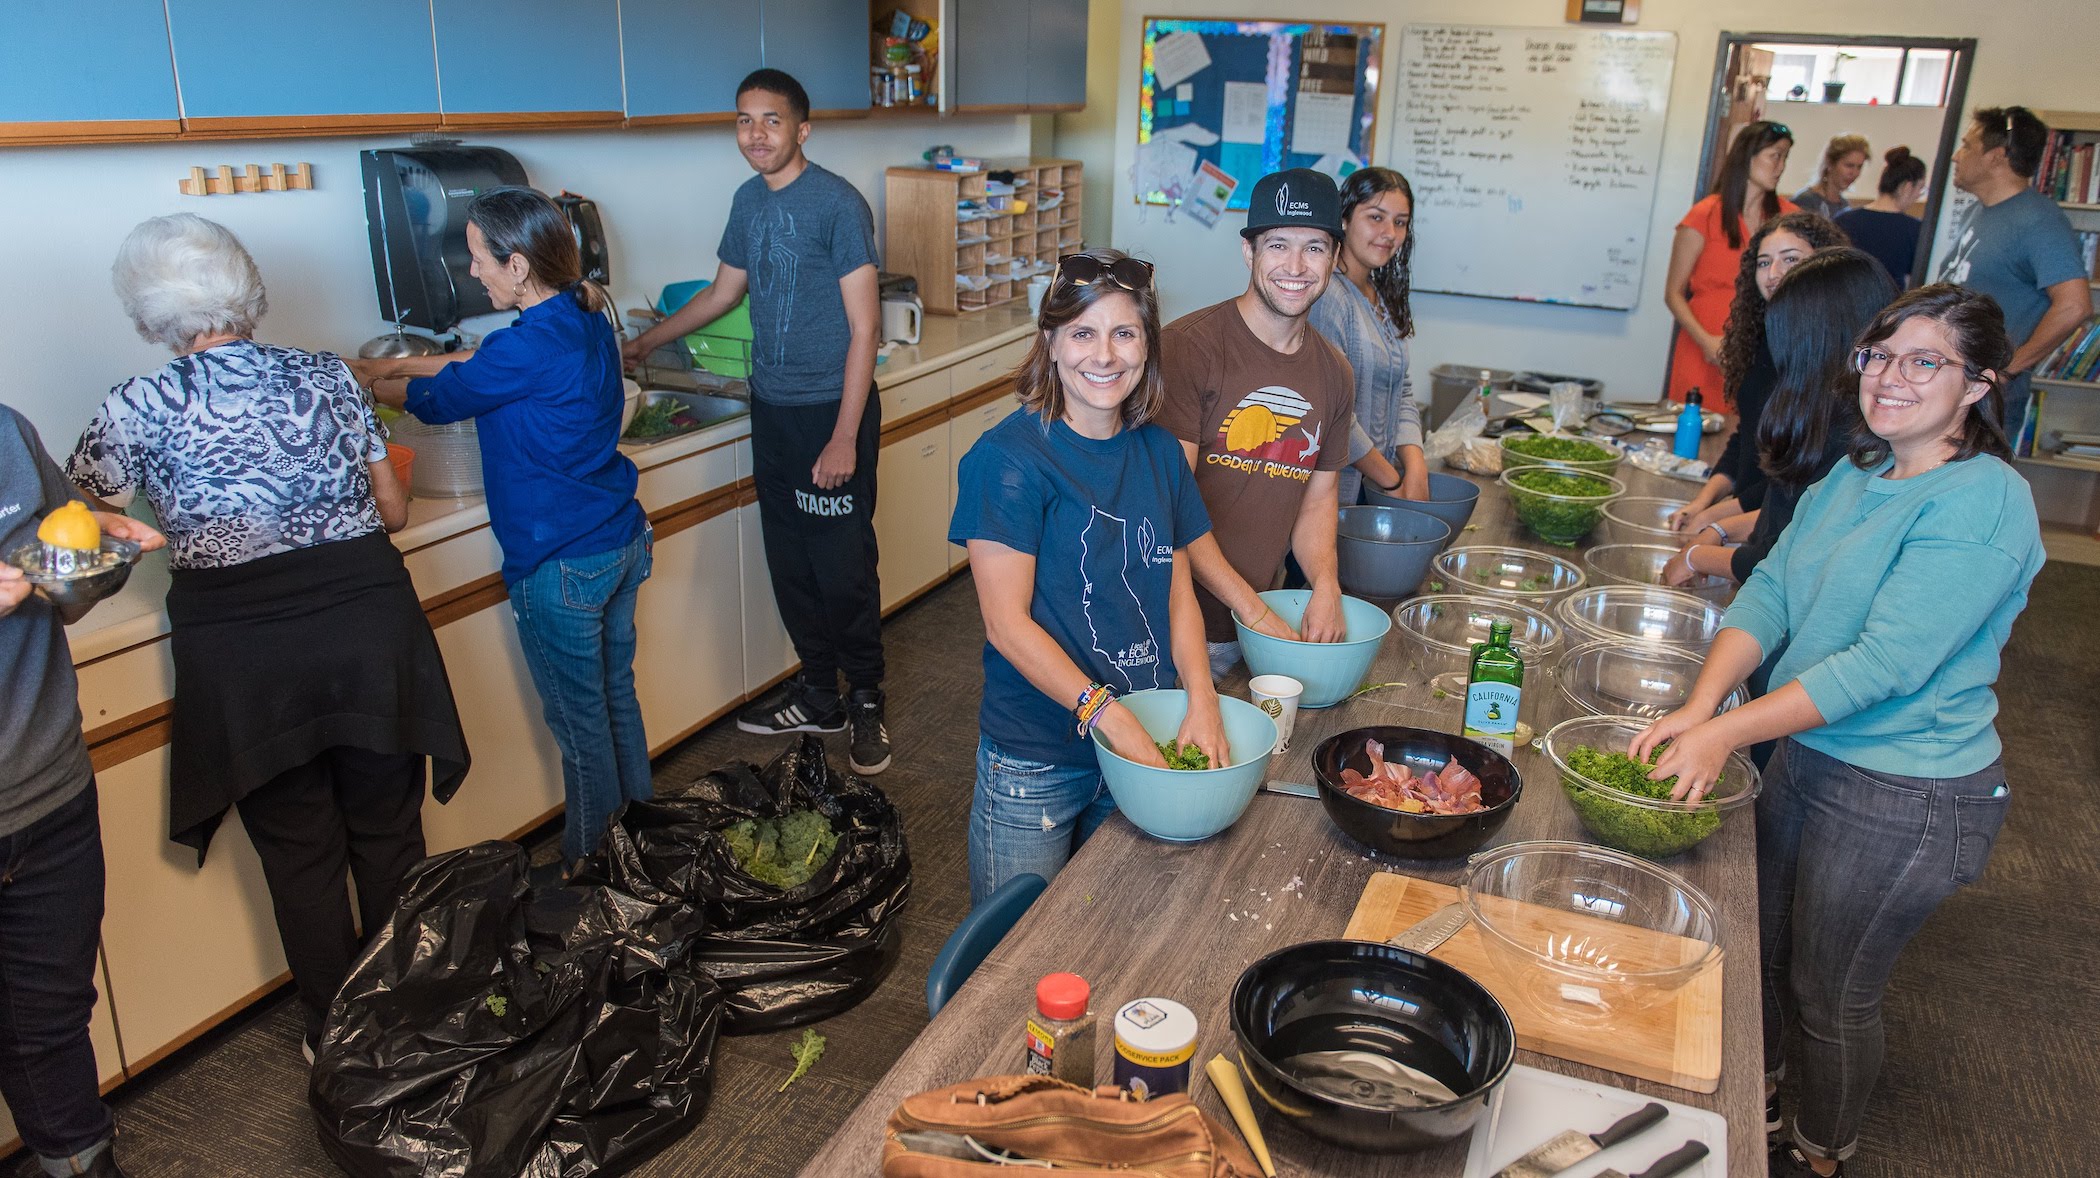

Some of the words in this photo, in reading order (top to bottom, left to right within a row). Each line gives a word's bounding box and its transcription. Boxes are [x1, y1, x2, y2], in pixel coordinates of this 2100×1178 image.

[1289, 202, 1309, 210] ECMS
[795, 489, 853, 516] STACKS
[1157, 545, 1173, 555] ECM
[1472, 691, 1518, 706] CALIFORNIA
[1160, 1054, 1180, 1063] PACK
